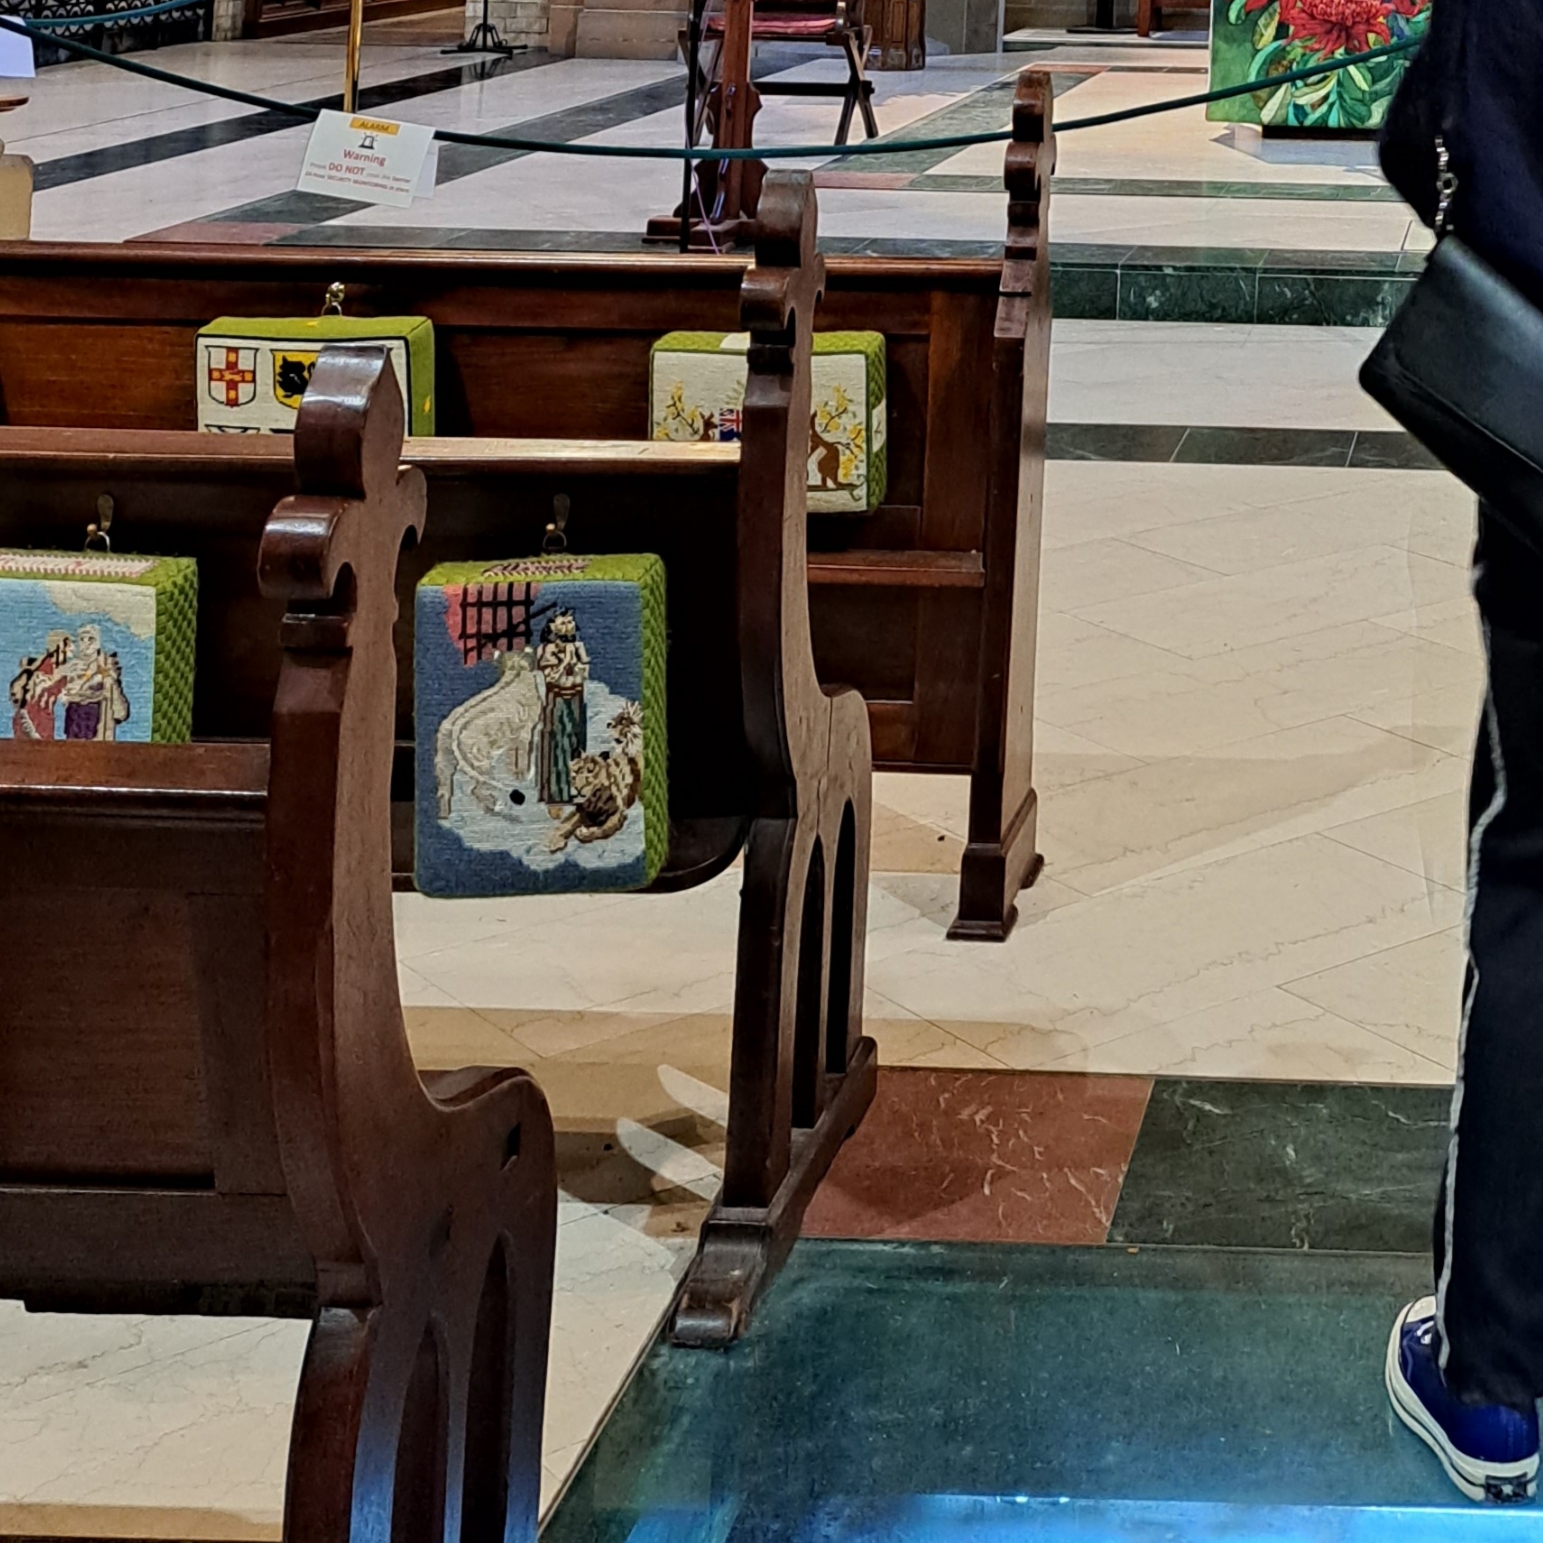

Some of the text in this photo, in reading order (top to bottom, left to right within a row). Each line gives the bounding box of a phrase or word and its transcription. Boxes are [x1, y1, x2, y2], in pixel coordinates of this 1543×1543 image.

[358, 121, 390, 132] ALARM
[343, 148, 387, 167] Warning
[328, 161, 343, 173] DO
[345, 164, 366, 176] NOT
